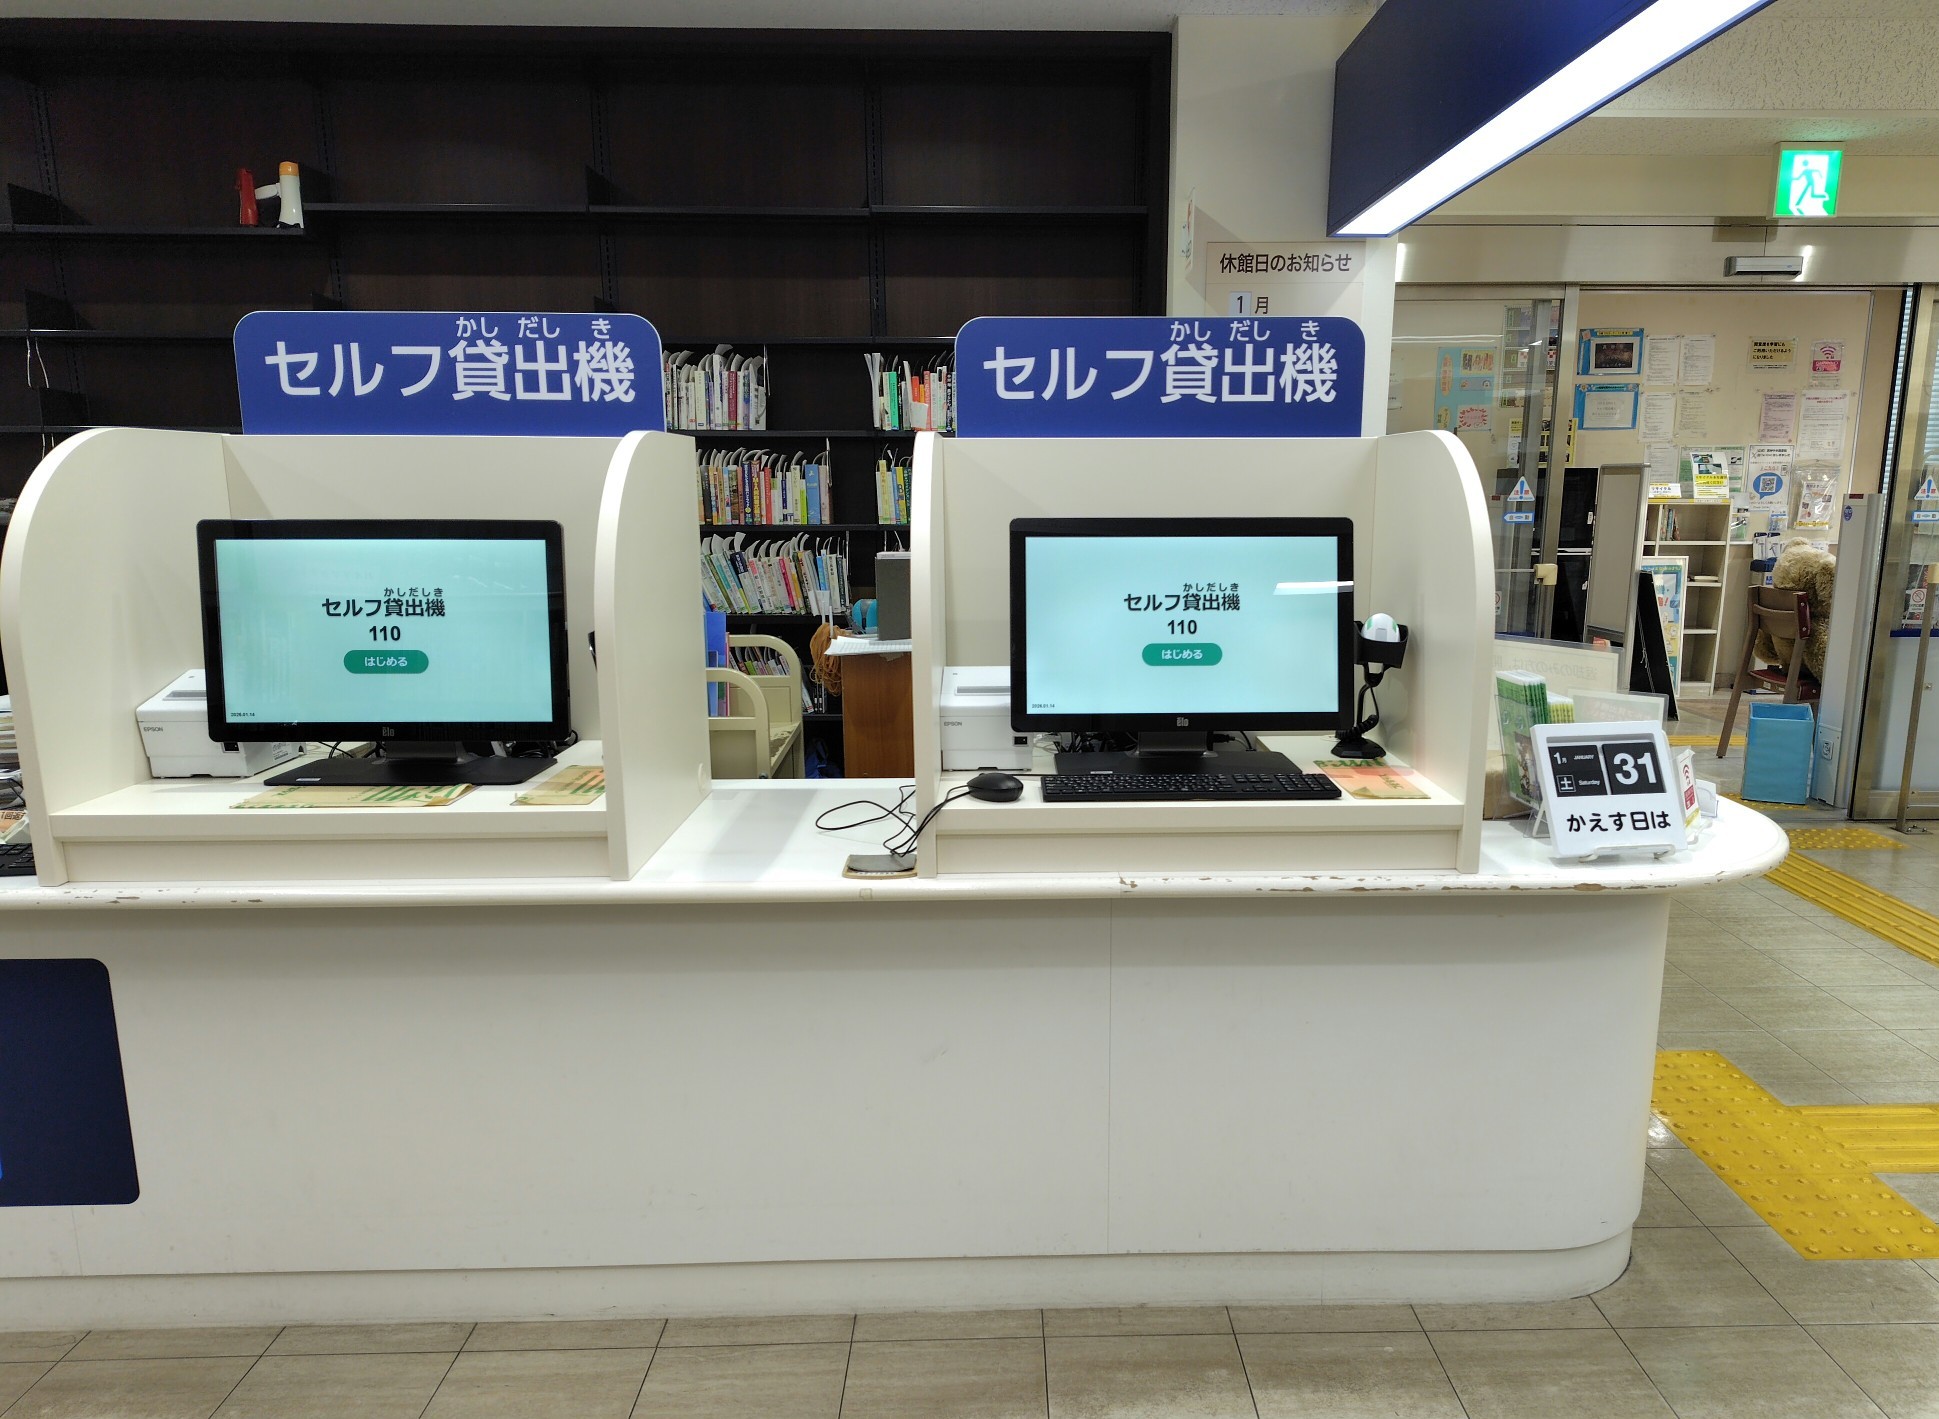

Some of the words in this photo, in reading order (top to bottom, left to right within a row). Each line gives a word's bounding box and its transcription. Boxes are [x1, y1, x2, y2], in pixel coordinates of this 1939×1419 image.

[1219, 253, 1352, 273] 休館日のお知らせ
[455, 316, 498, 338] かし
[517, 316, 560, 338] だし
[591, 318, 612, 339] き
[1170, 320, 1211, 341] かし
[1229, 320, 1270, 341] だし
[1299, 320, 1320, 341] き
[264, 338, 636, 403] セルフ貸出機
[983, 343, 1338, 404] セルフ貸出機
[383, 587, 444, 597] かしだしき
[1182, 582, 1239, 592] かしだしき
[321, 597, 446, 618] セルフ貸出機
[1123, 592, 1241, 612] セルフ貸出機
[368, 625, 401, 642] 110
[1167, 619, 1198, 635] 110
[364, 656, 408, 668] はじめる
[1161, 649, 1203, 660] はじめる
[1613, 752, 1657, 785] 31
[1560, 777, 1573, 790] 土
[1579, 779, 1601, 787] Saturday
[1567, 810, 1671, 833] かえす日は
